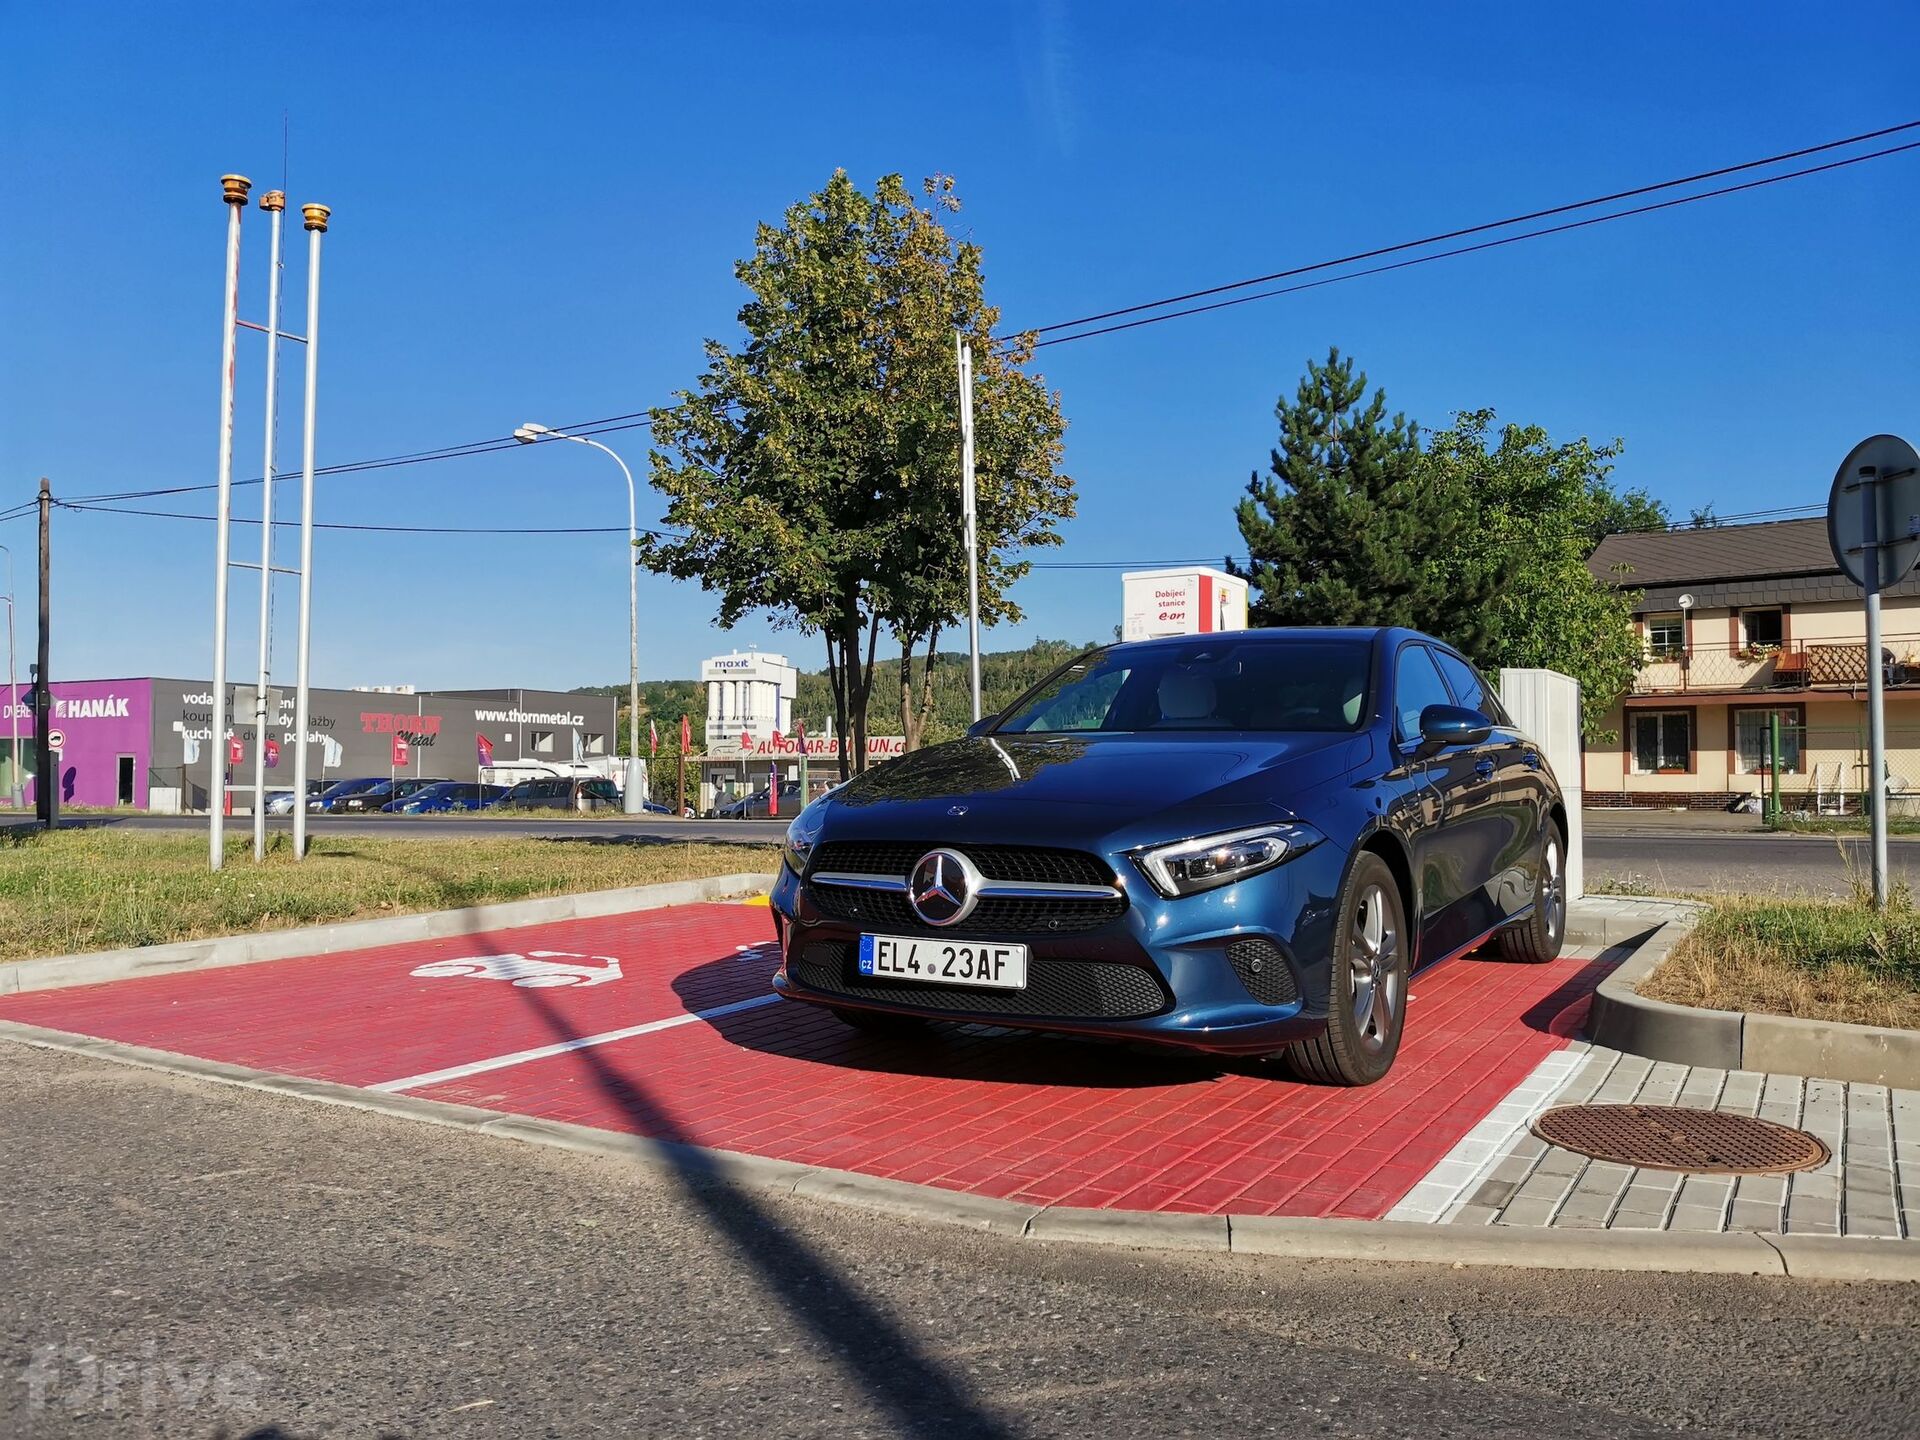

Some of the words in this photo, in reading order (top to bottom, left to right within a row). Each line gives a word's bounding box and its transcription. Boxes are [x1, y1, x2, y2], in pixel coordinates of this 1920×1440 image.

[1158, 599, 1186, 608] stanice
[714, 659, 749, 668] maxit
[68, 694, 129, 718] HANÁK
[182, 691, 214, 705] voda
[306, 714, 336, 729] lažby
[361, 712, 442, 733] THORN
[474, 708, 584, 726] www.thornmetal.cz
[283, 730, 328, 746] polahy
[397, 730, 437, 747] Metal
[861, 959, 872, 970] CZ
[877, 941, 921, 974] EL4
[941, 946, 1010, 981] 23AF
